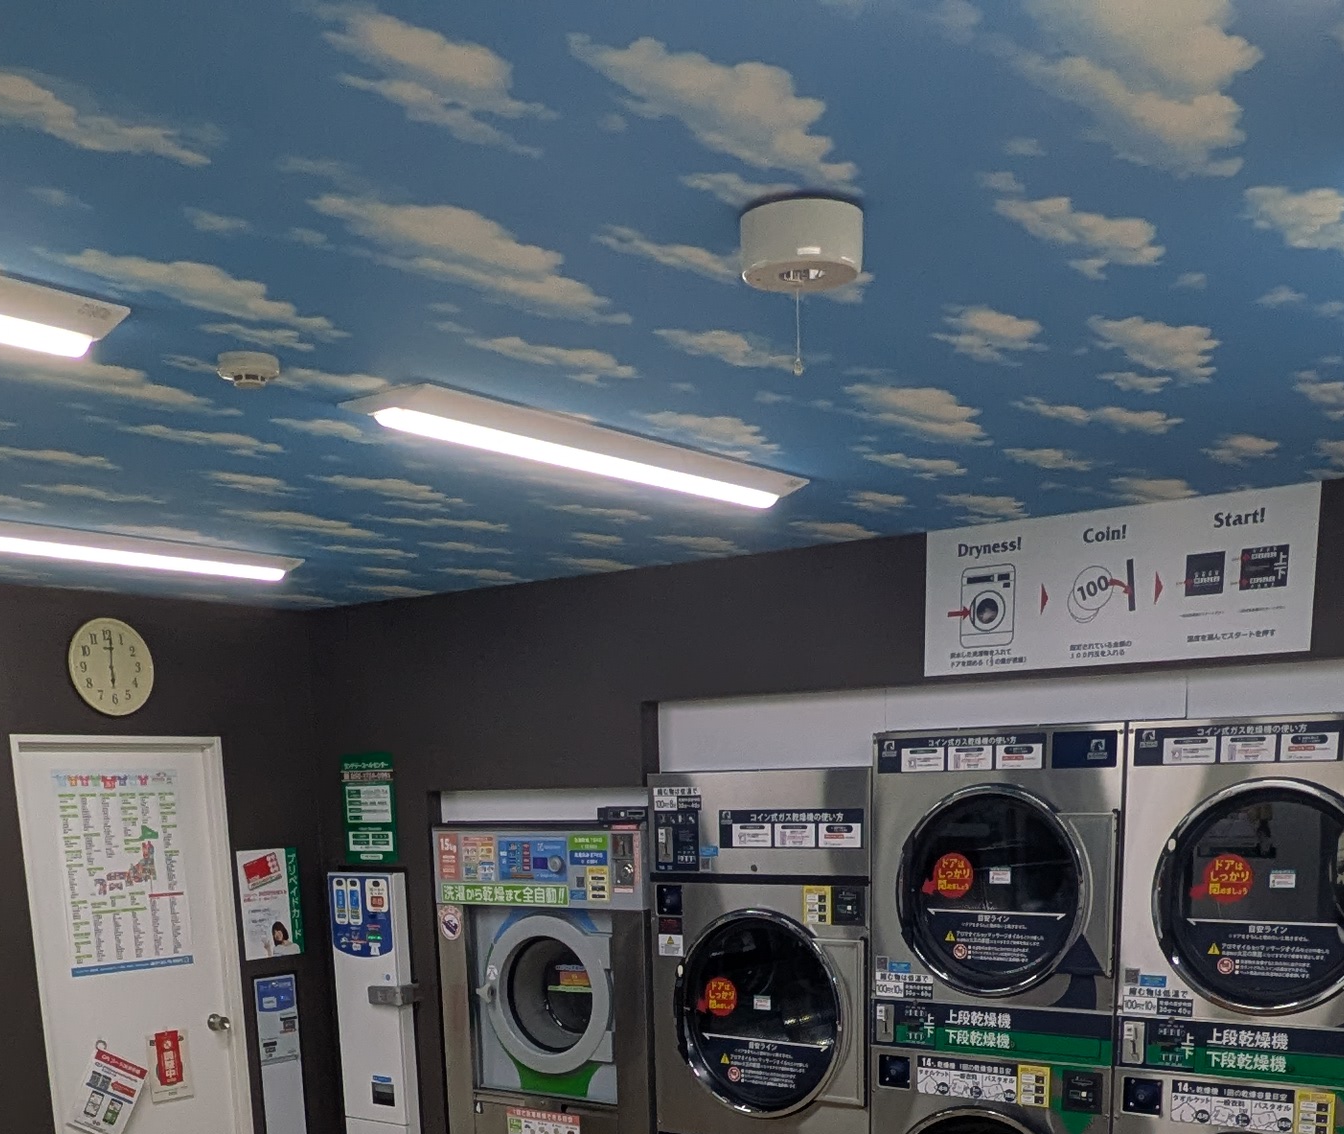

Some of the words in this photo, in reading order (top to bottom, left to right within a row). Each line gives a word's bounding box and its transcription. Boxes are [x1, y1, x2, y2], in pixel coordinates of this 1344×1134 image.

[1213, 507, 1266, 528] Start!
[1083, 525, 1127, 544] Coin!
[958, 537, 1022, 559] Dryness!
[1076, 576, 1110, 600] 100
[90, 633, 98, 645] 11
[102, 629, 111, 640] 12
[119, 634, 123, 645] 1
[81, 645, 90, 656] 10
[129, 646, 135, 657] 2
[80, 661, 87, 673] 9
[135, 662, 141, 673] 3
[86, 678, 93, 688] 8
[132, 678, 138, 688] 4
[98, 690, 103, 700] 7
[112, 694, 118, 705] 6
[125, 690, 131, 700] 5
[1197, 724, 1308, 736] コイン式ガス乾燥機の使い方
[928, 736, 1017, 747] コイン式ガス乾燥機の使い方
[750, 812, 844, 823] コイン式ガス乾燥機の使い方
[941, 858, 964, 868] ドアは
[1215, 860, 1243, 871] ドアは
[938, 868, 970, 879] しっかり
[1210, 871, 1250, 882] しっかり
[287, 853, 301, 938] プリペイドカード
[711, 982, 730, 990] ドアは
[709, 990, 735, 1000] しっかり
[1129, 987, 1188, 999] 縮む物は低温で
[924, 1014, 935, 1026] 上
[945, 1010, 1011, 1029] 上段乾燥機
[924, 1026, 935, 1038] 下
[945, 1029, 1010, 1049] 下段乾燥機
[1181, 1033, 1194, 1046] 上
[1207, 1028, 1288, 1050] 上段乾燥機
[1181, 1046, 1194, 1059] 下
[1206, 1051, 1287, 1073] 下段乾燥機
